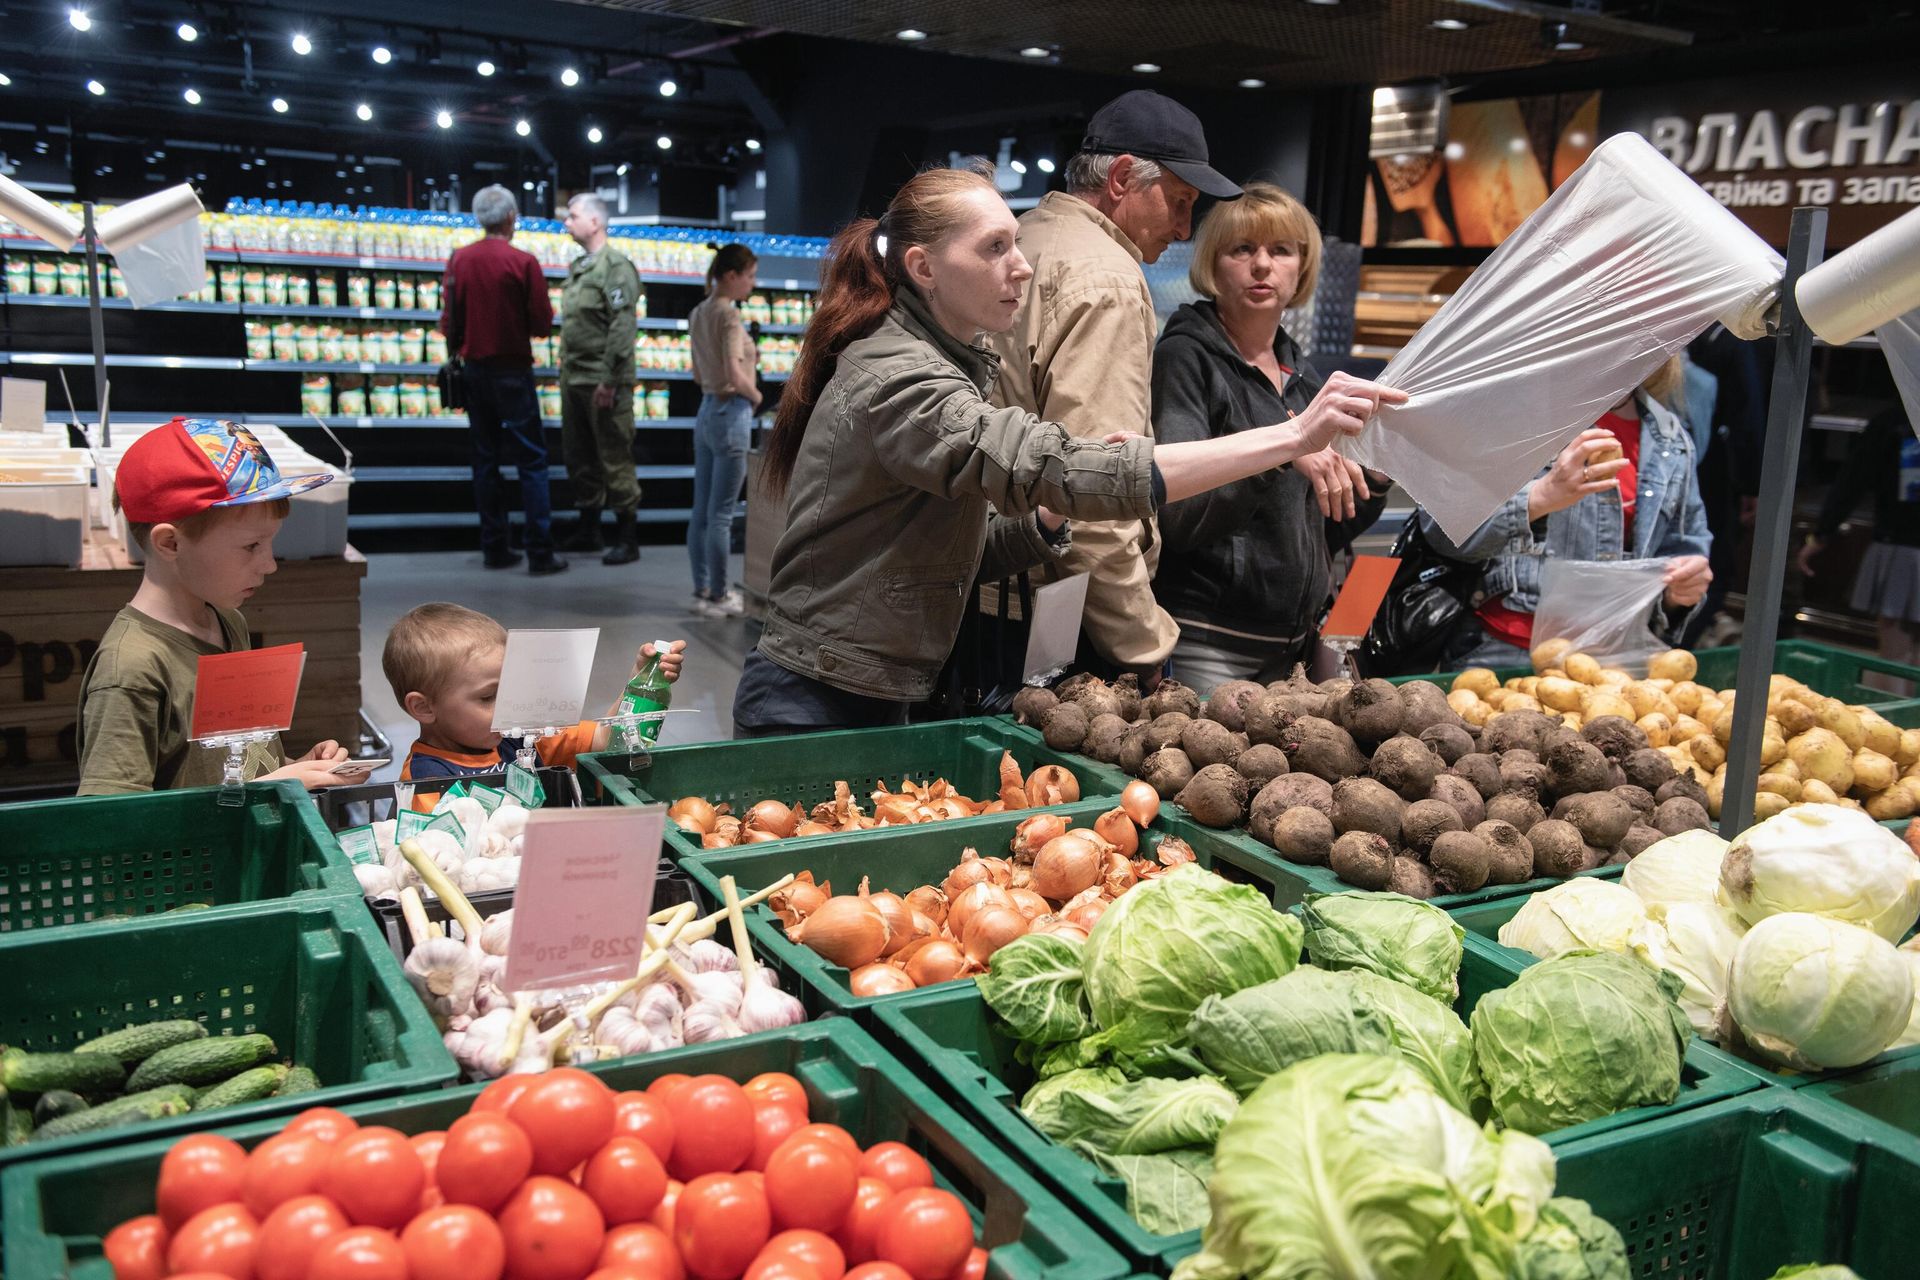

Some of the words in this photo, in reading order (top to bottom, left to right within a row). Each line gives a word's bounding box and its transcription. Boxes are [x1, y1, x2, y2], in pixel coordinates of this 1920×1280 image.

[1651, 101, 1920, 174] ВЛАСНА
[1796, 177, 1836, 205] та
[611, 289, 625, 306] Z
